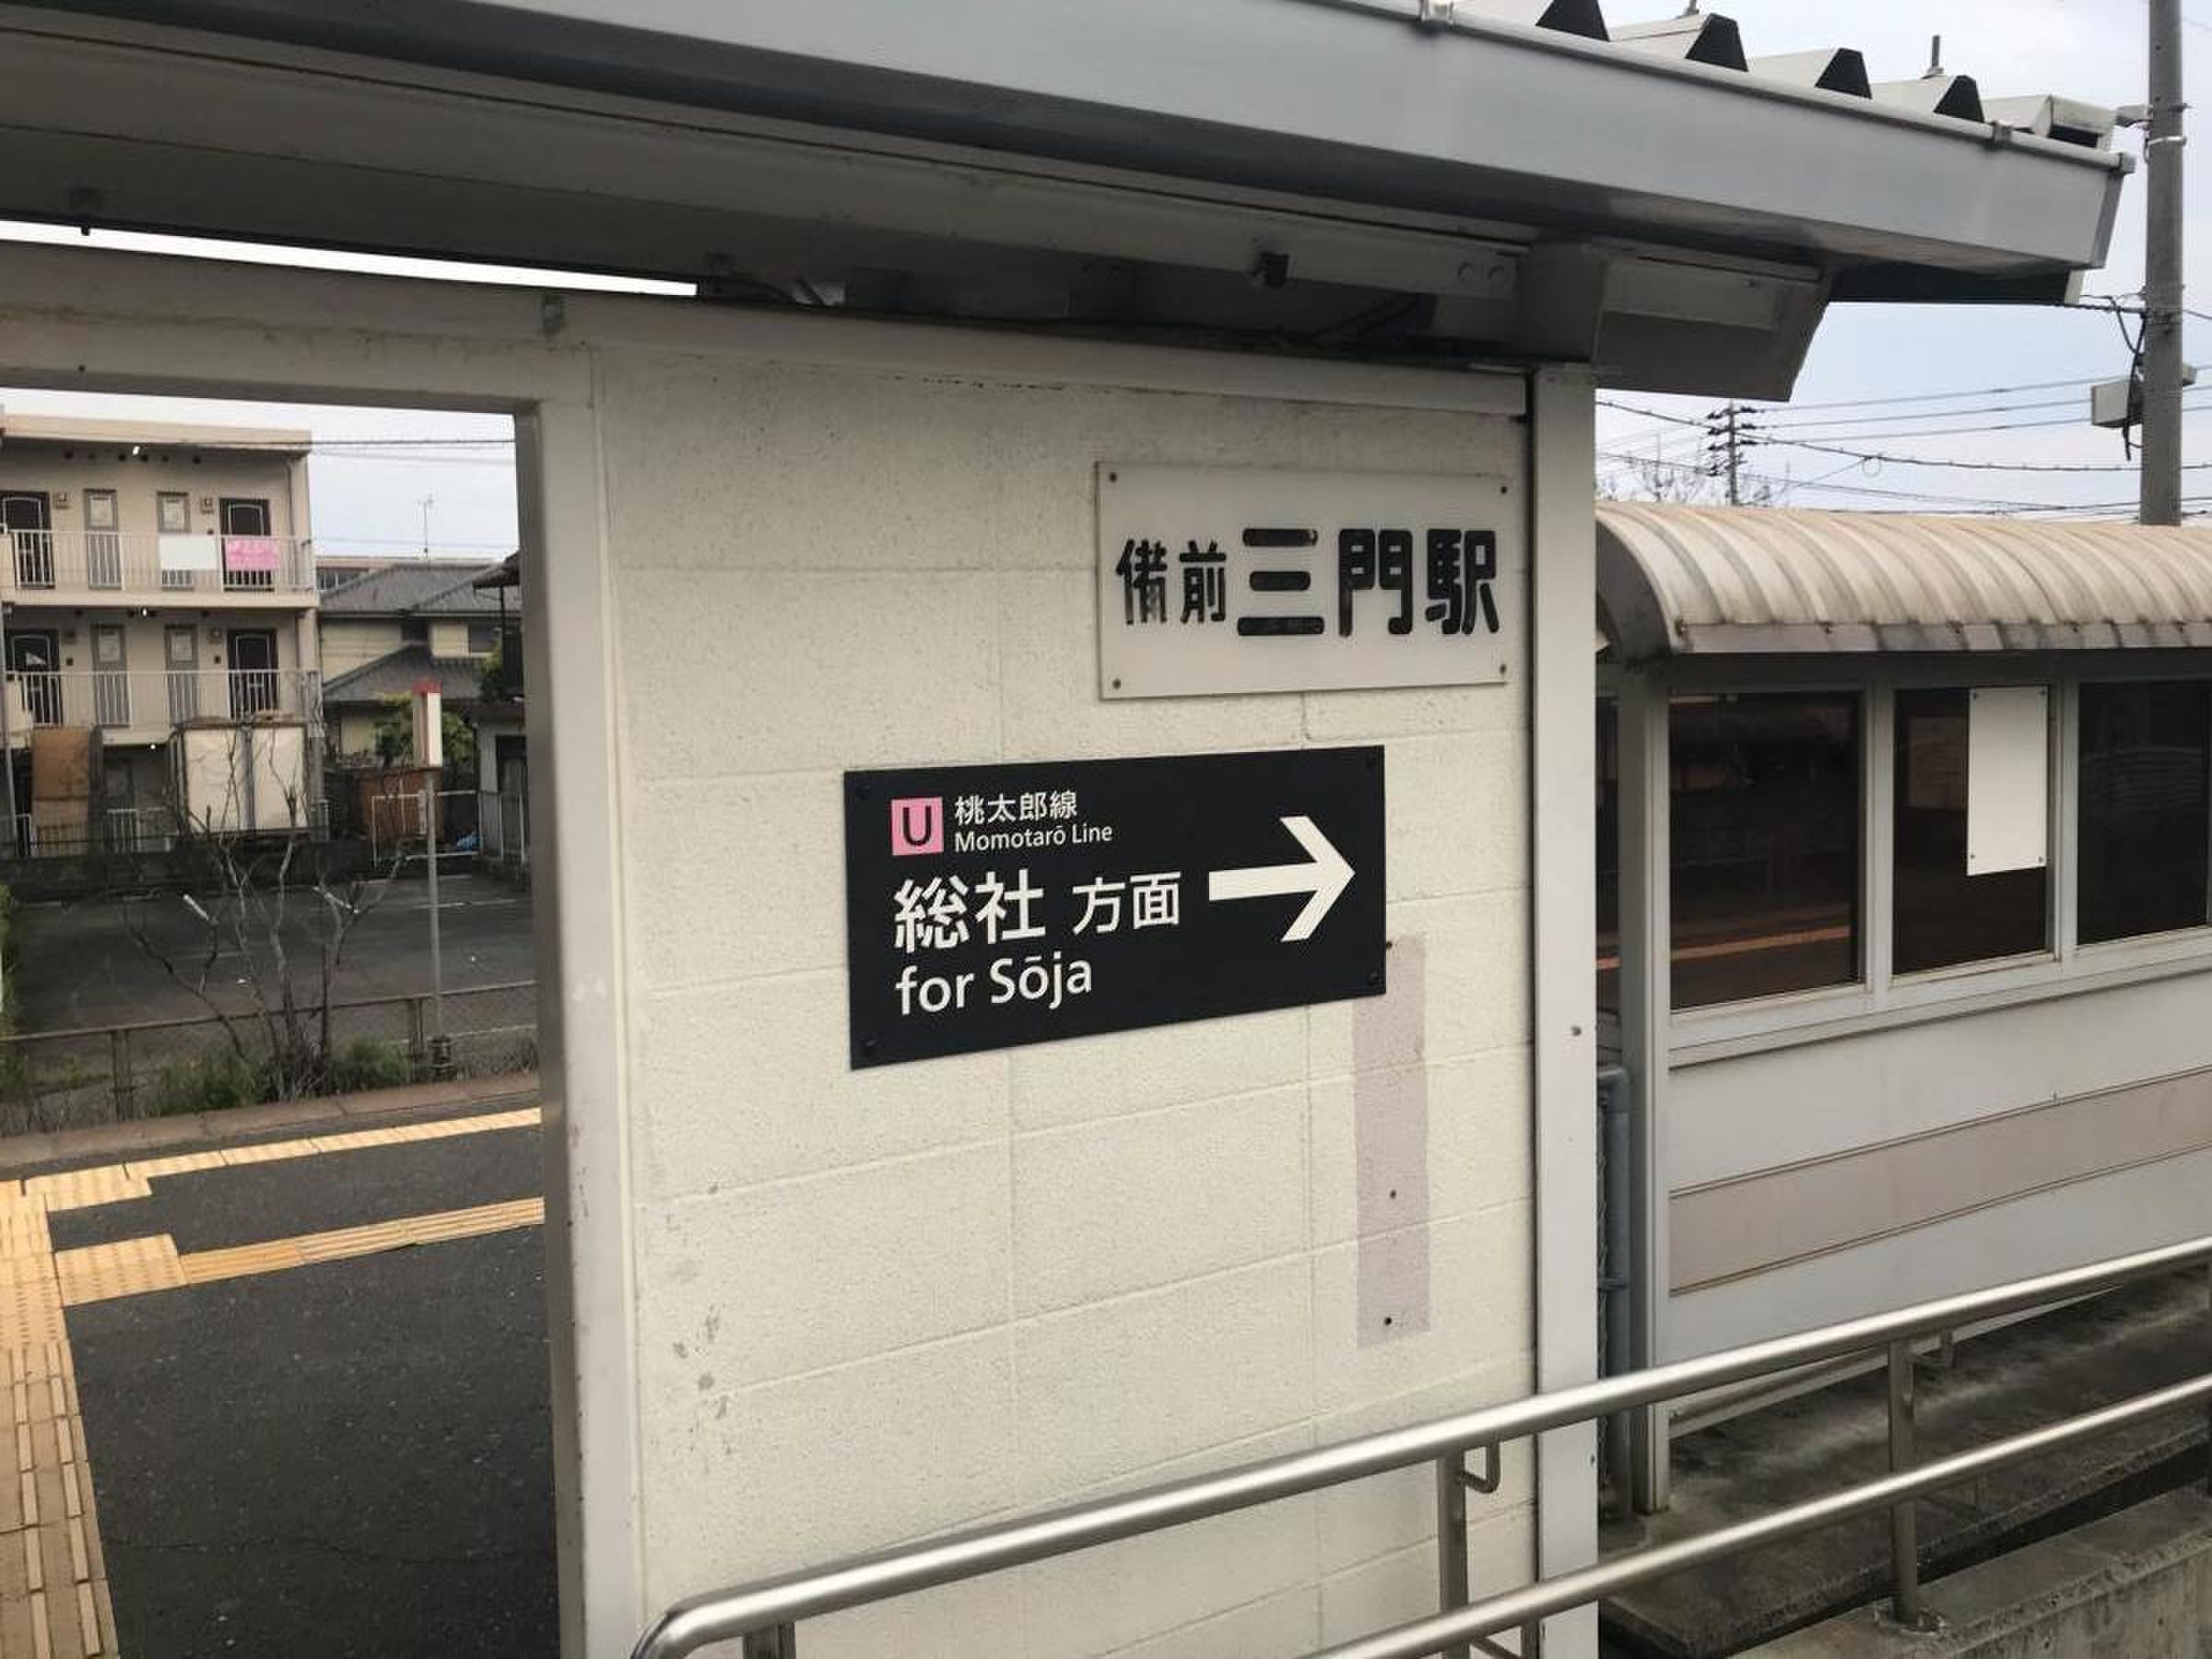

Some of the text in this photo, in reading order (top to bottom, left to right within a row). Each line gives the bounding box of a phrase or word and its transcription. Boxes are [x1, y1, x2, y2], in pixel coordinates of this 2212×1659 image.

[902, 805, 932, 847] U
[955, 790, 1077, 825] 桃太郎線
[955, 822, 1112, 853] Momotarō Line
[894, 869, 1182, 955] 総社 方面
[895, 951, 1092, 1016] for Sōja
